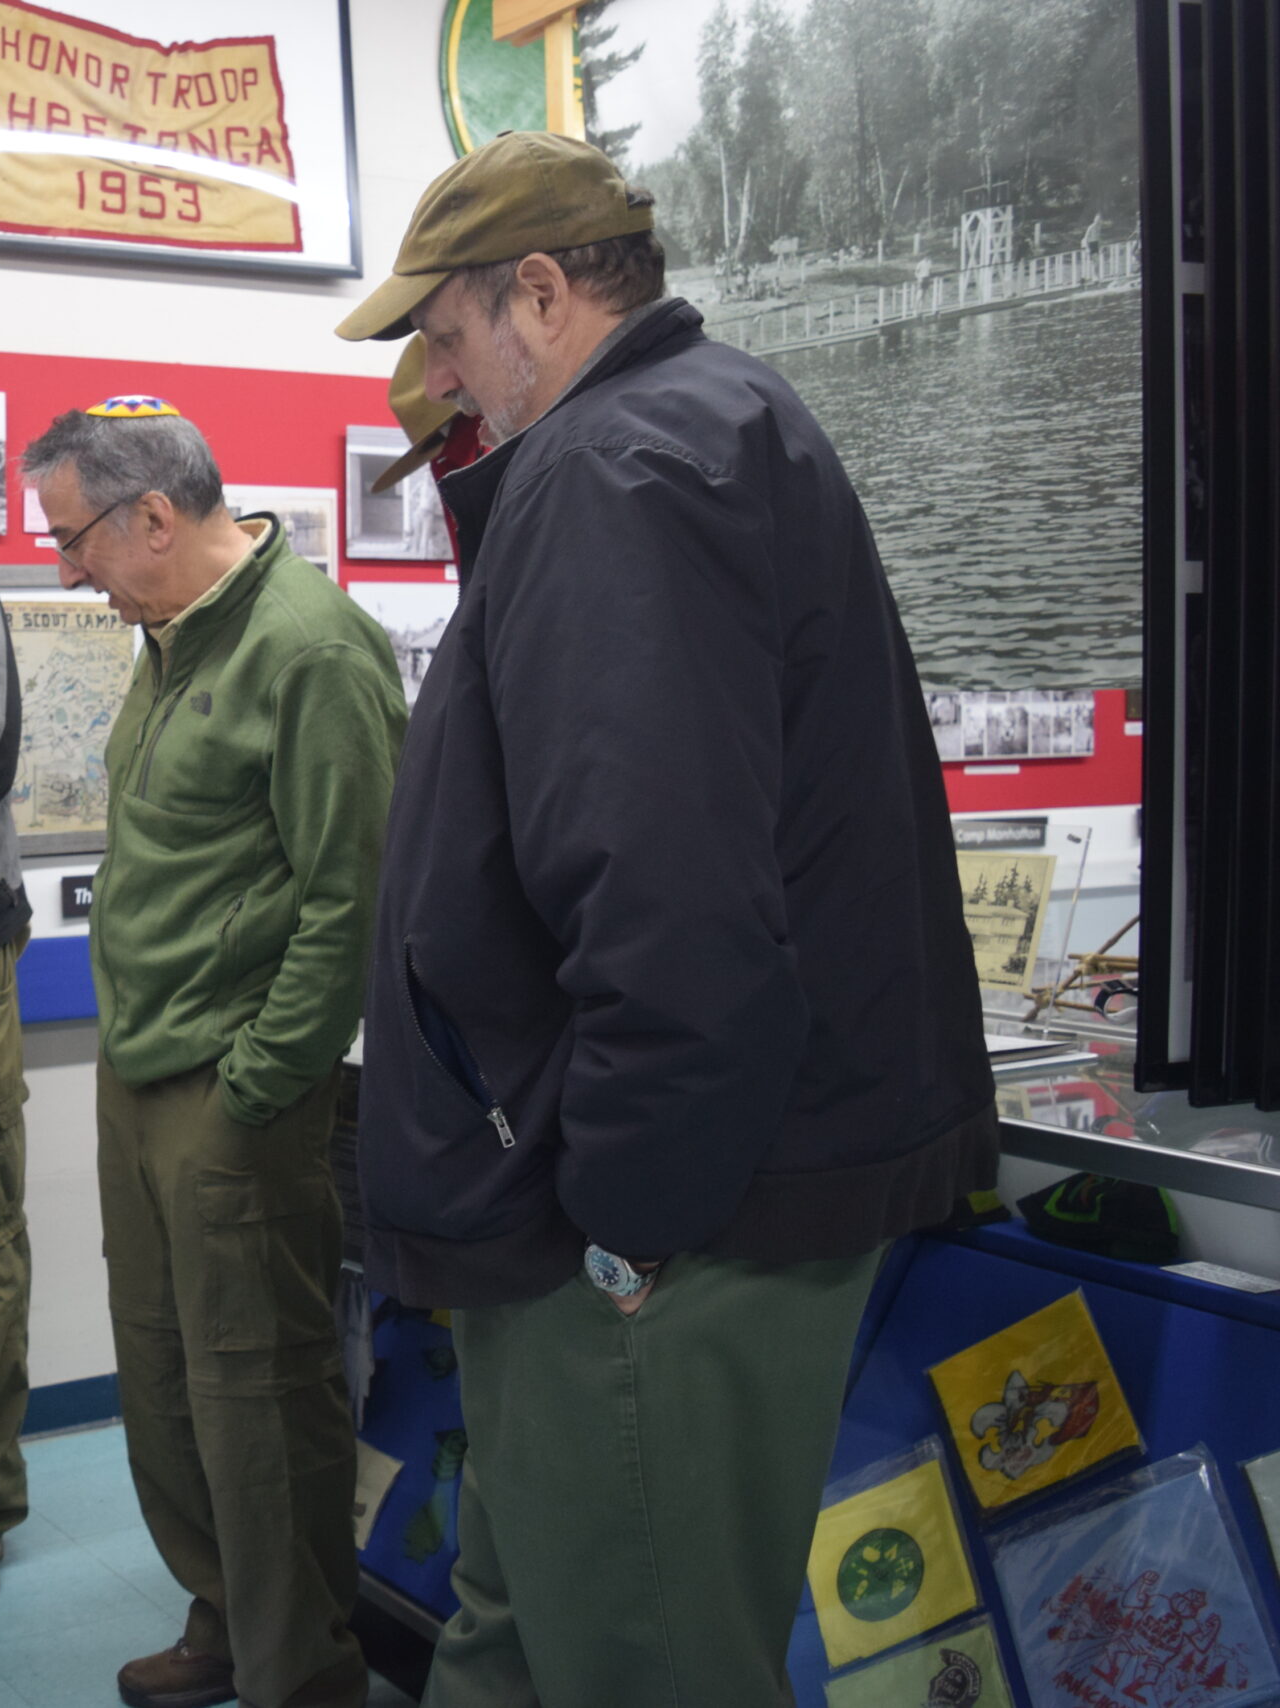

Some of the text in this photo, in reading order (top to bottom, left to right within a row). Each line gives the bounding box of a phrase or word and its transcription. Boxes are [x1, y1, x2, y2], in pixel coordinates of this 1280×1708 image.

[1, 26, 259, 110] HONOR TROOP
[76, 170, 202, 223] 1953
[23, 613, 68, 628] SCOUT
